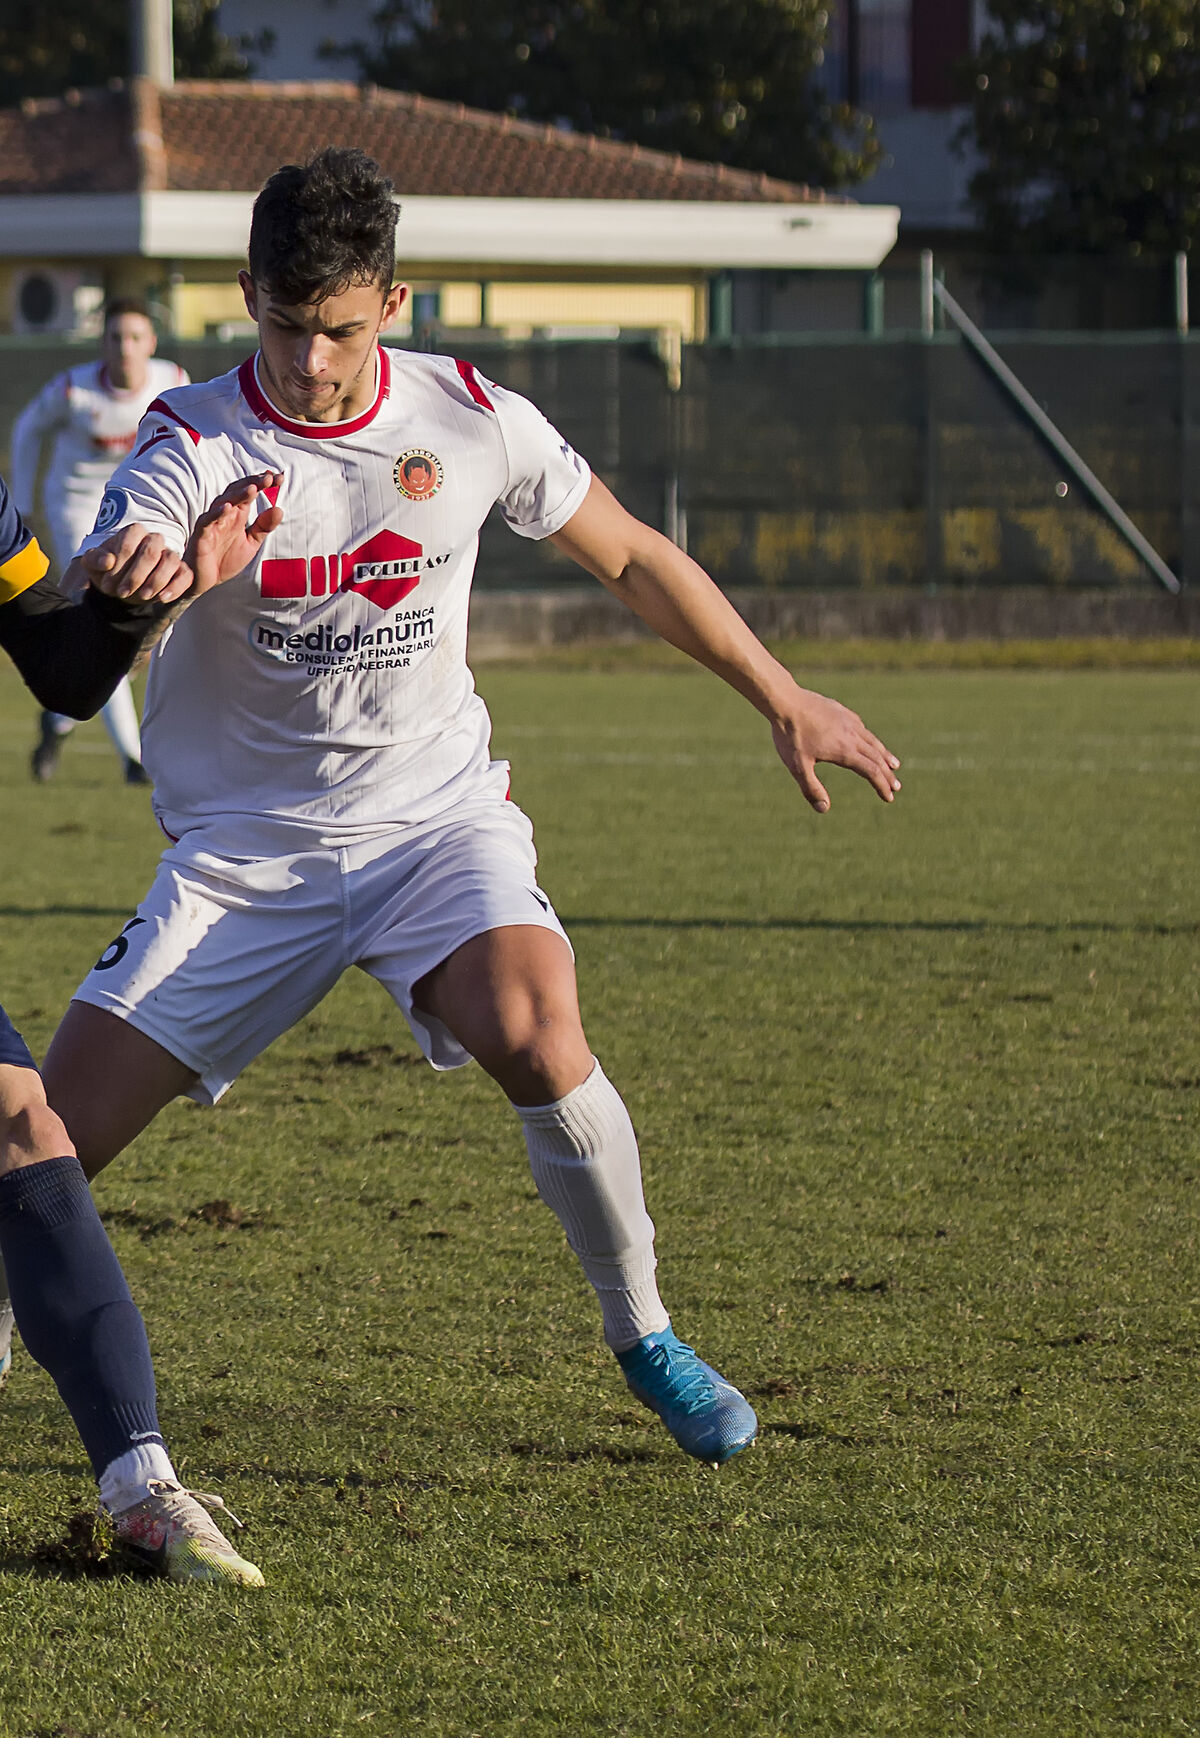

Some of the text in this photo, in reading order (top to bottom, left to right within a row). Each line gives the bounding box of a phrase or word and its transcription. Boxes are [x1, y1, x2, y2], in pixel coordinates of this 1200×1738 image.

[356, 553, 453, 579] POLIPLAST
[395, 606, 435, 623] BANCA
[257, 618, 434, 652] mediolanum
[368, 638, 434, 659] FINANZIARI
[307, 657, 411, 677] UFFICIO NEGRAR
